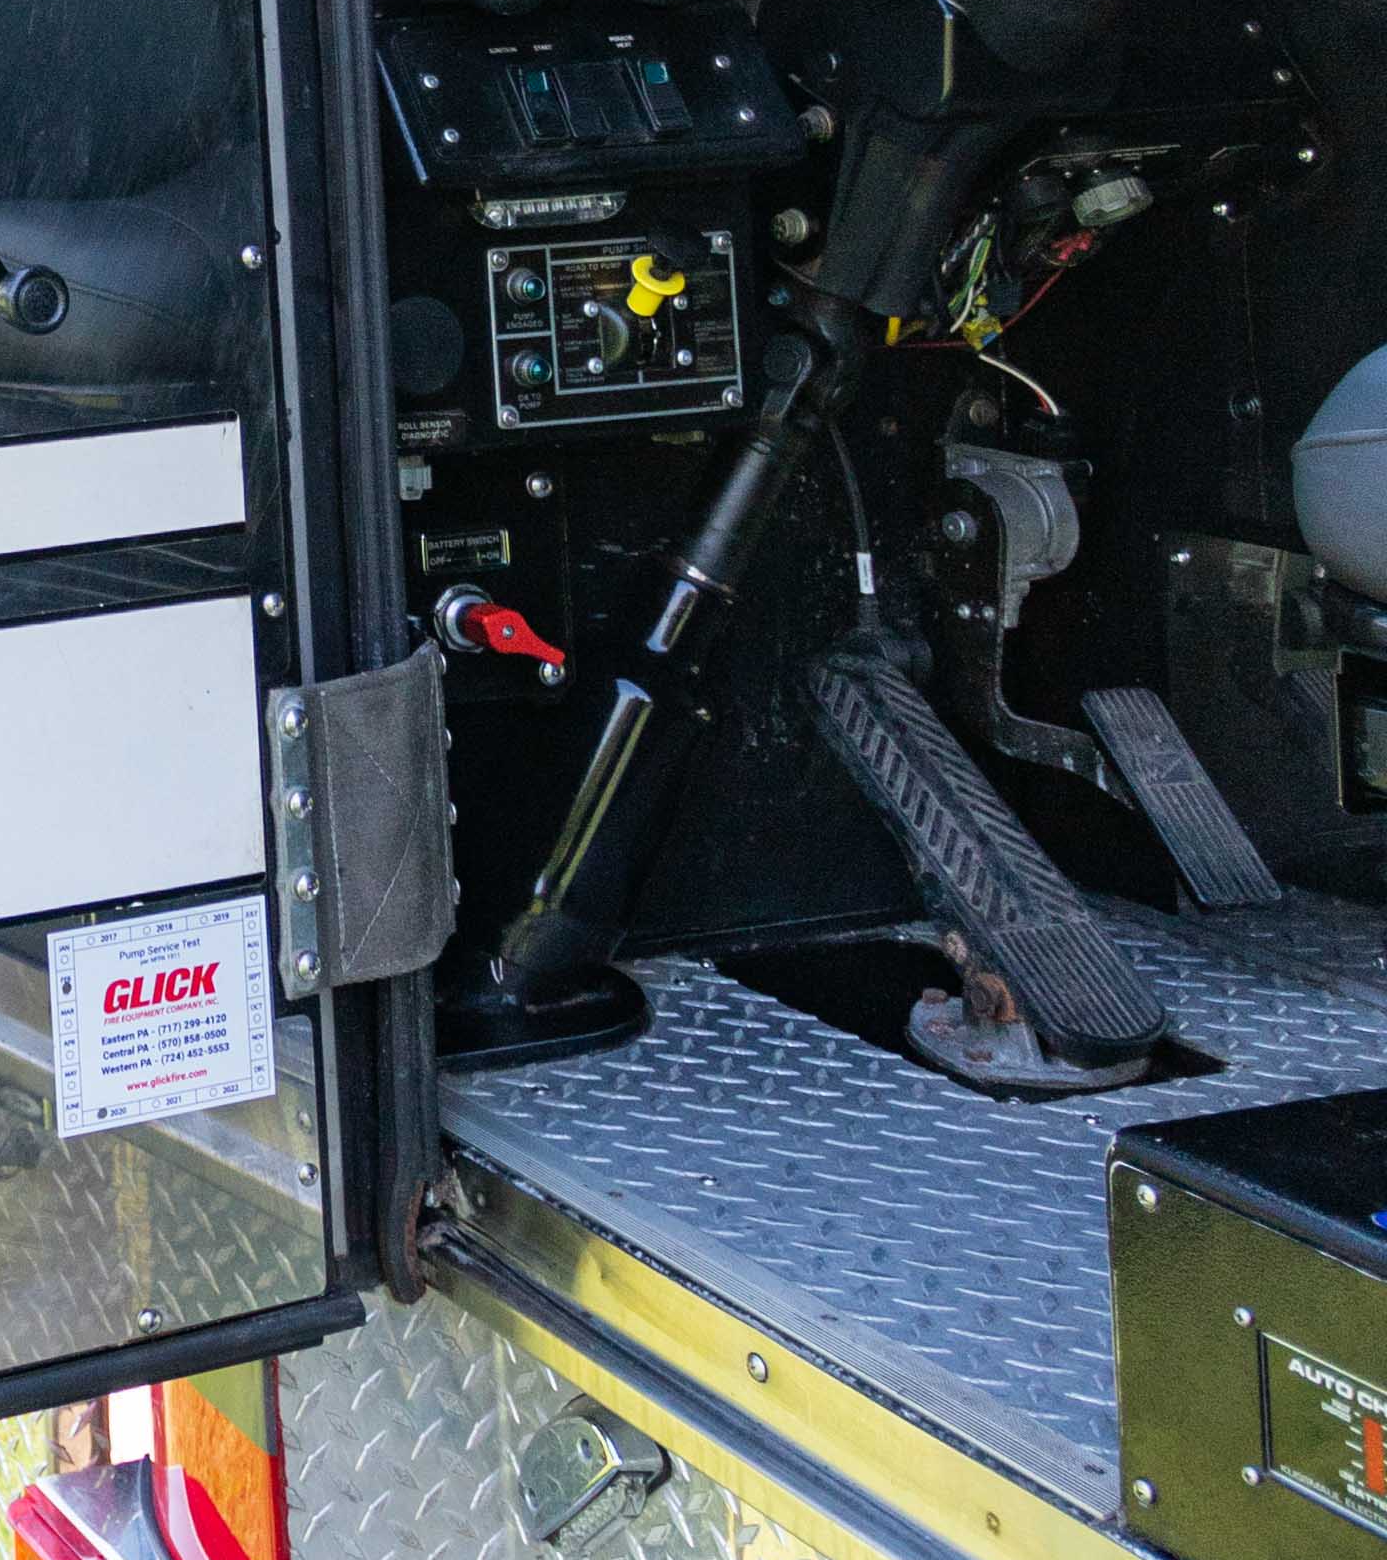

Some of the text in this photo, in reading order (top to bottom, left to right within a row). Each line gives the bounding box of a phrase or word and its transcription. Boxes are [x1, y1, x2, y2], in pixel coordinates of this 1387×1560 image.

[428, 535, 500, 551] BATTERY SWITCH
[100, 912, 230, 943] 2017 2018 2019
[119, 949, 145, 959] Pump
[147, 943, 179, 955] Service
[182, 937, 200, 948] Test
[102, 962, 220, 1015] GLICK
[101, 1013, 226, 1045] Eastern PA (717) 299-4120
[102, 1028, 226, 1059] Central PA (570) 858-0500
[101, 1043, 229, 1074] Western PA (724) 452-5553
[126, 1068, 208, 1092] www.glickfire.com
[1288, 1357, 1354, 1401] AUTO
